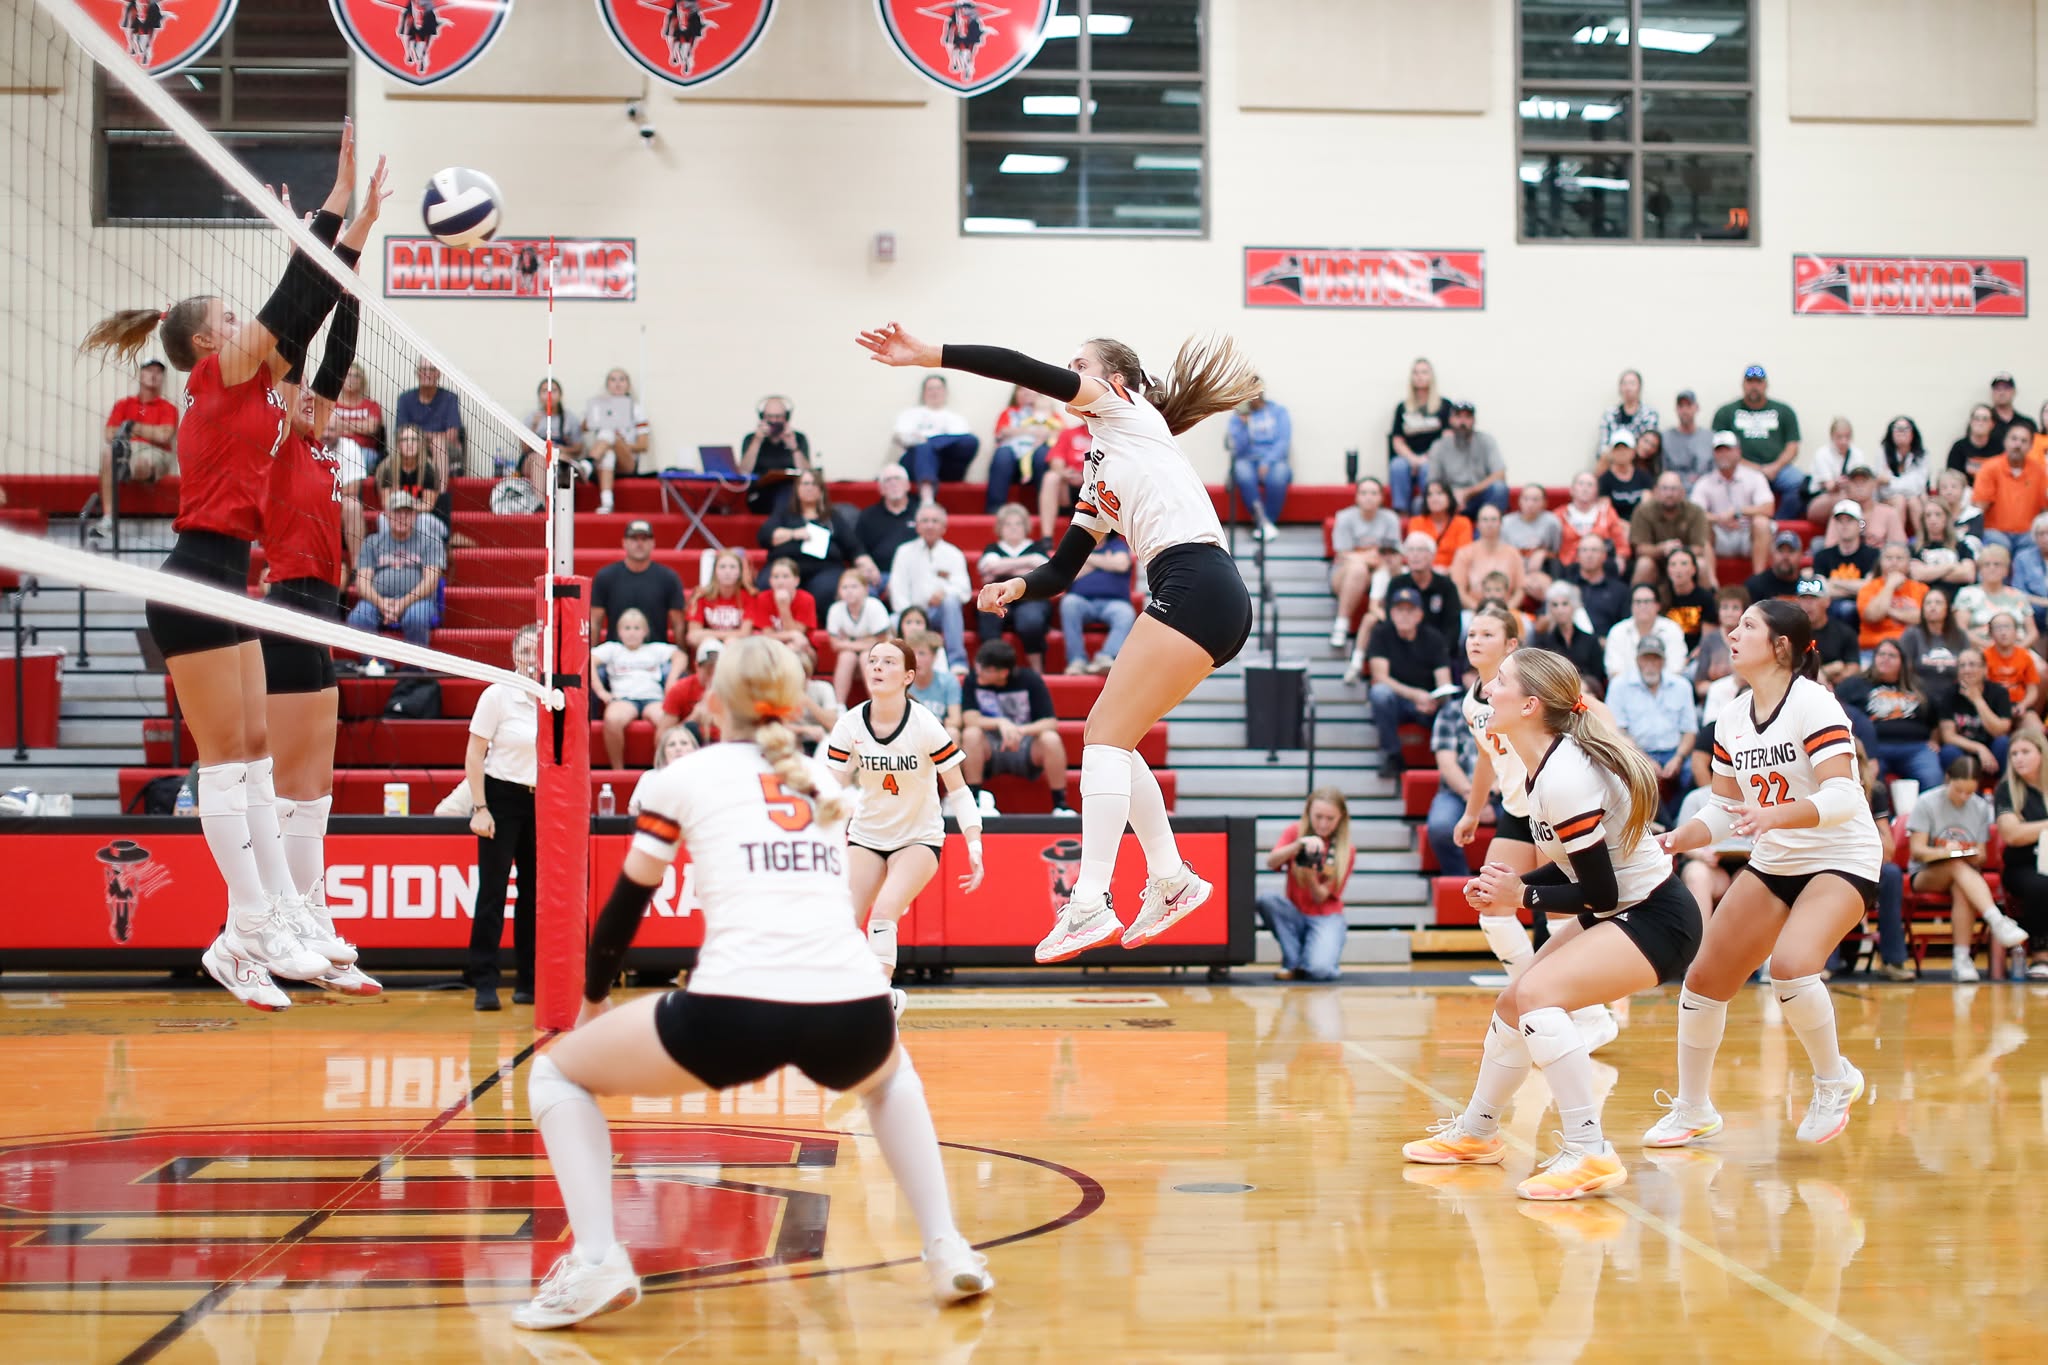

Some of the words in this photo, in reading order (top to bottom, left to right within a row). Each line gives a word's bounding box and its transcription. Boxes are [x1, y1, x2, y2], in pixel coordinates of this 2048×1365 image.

[391, 244, 514, 292] RAIDER
[541, 246, 629, 292] FANS
[1301, 256, 1430, 303] VISITOR
[1849, 264, 1972, 310] VISITOR
[1486, 733, 1508, 756] 2
[1735, 742, 1797, 771] STERLING
[758, 772, 815, 832] 5
[882, 773, 900, 796] 4
[1750, 771, 1796, 808] 22
[740, 840, 842, 876] TIGERS
[325, 864, 519, 920] SIDN
